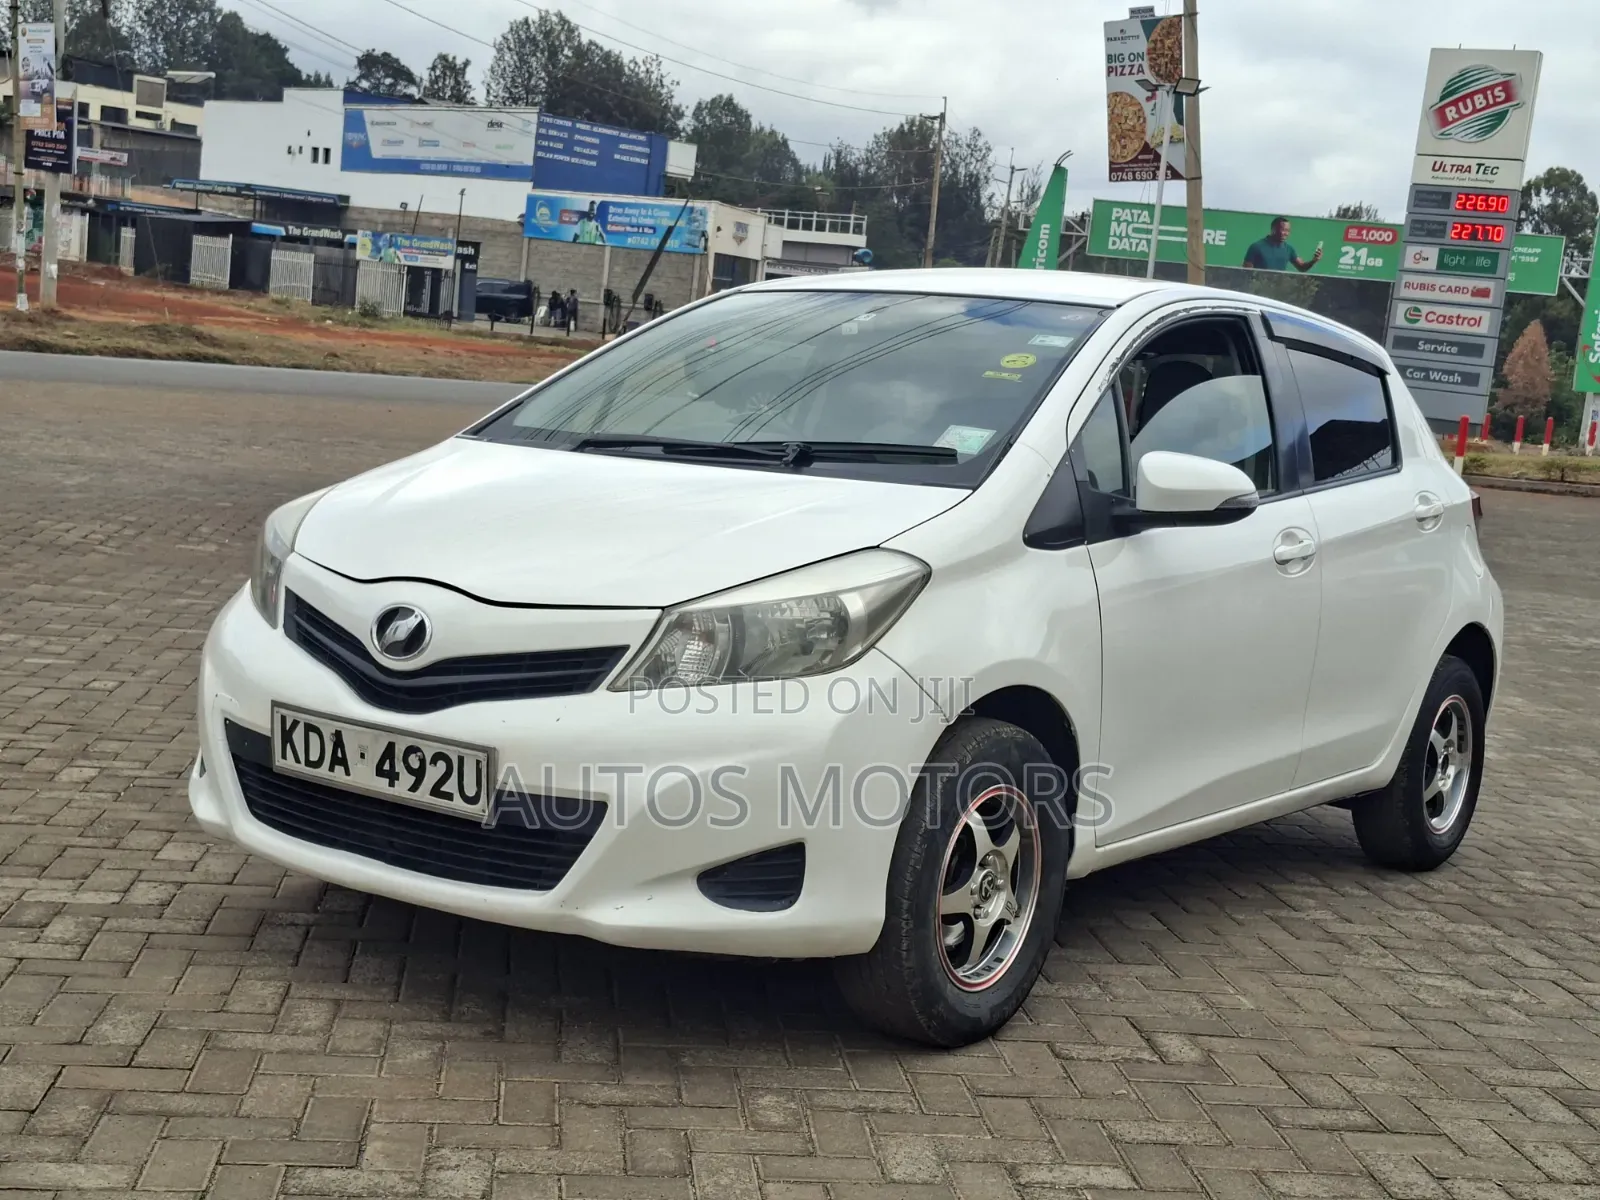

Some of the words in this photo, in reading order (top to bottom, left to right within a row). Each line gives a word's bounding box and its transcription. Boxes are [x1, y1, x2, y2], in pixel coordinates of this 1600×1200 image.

[1107, 53, 1125, 64] BIG
[1128, 52, 1145, 63] ON
[1107, 64, 1145, 77] PIZZA
[1111, 172, 1133, 182] 0748
[1135, 171, 1153, 180] 690
[1455, 194, 1509, 212] 226.90
[1111, 207, 1151, 223] PATA
[288, 225, 301, 236] The
[303, 226, 343, 240] GrandWash
[1361, 229, 1393, 242] 1,000
[1451, 223, 1504, 242] 227.70
[398, 237, 410, 247] The
[412, 239, 453, 250] GrandWash
[1108, 236, 1149, 253] DATA
[1444, 253, 1466, 267] light
[1475, 256, 1491, 267] life
[1438, 284, 1469, 295] CARD
[1425, 311, 1483, 328] Castrol
[1418, 341, 1459, 354] Service
[1406, 368, 1426, 378] Car
[1429, 371, 1461, 383] Wash
[280, 714, 351, 777] KDA
[375, 741, 483, 806] 492U
